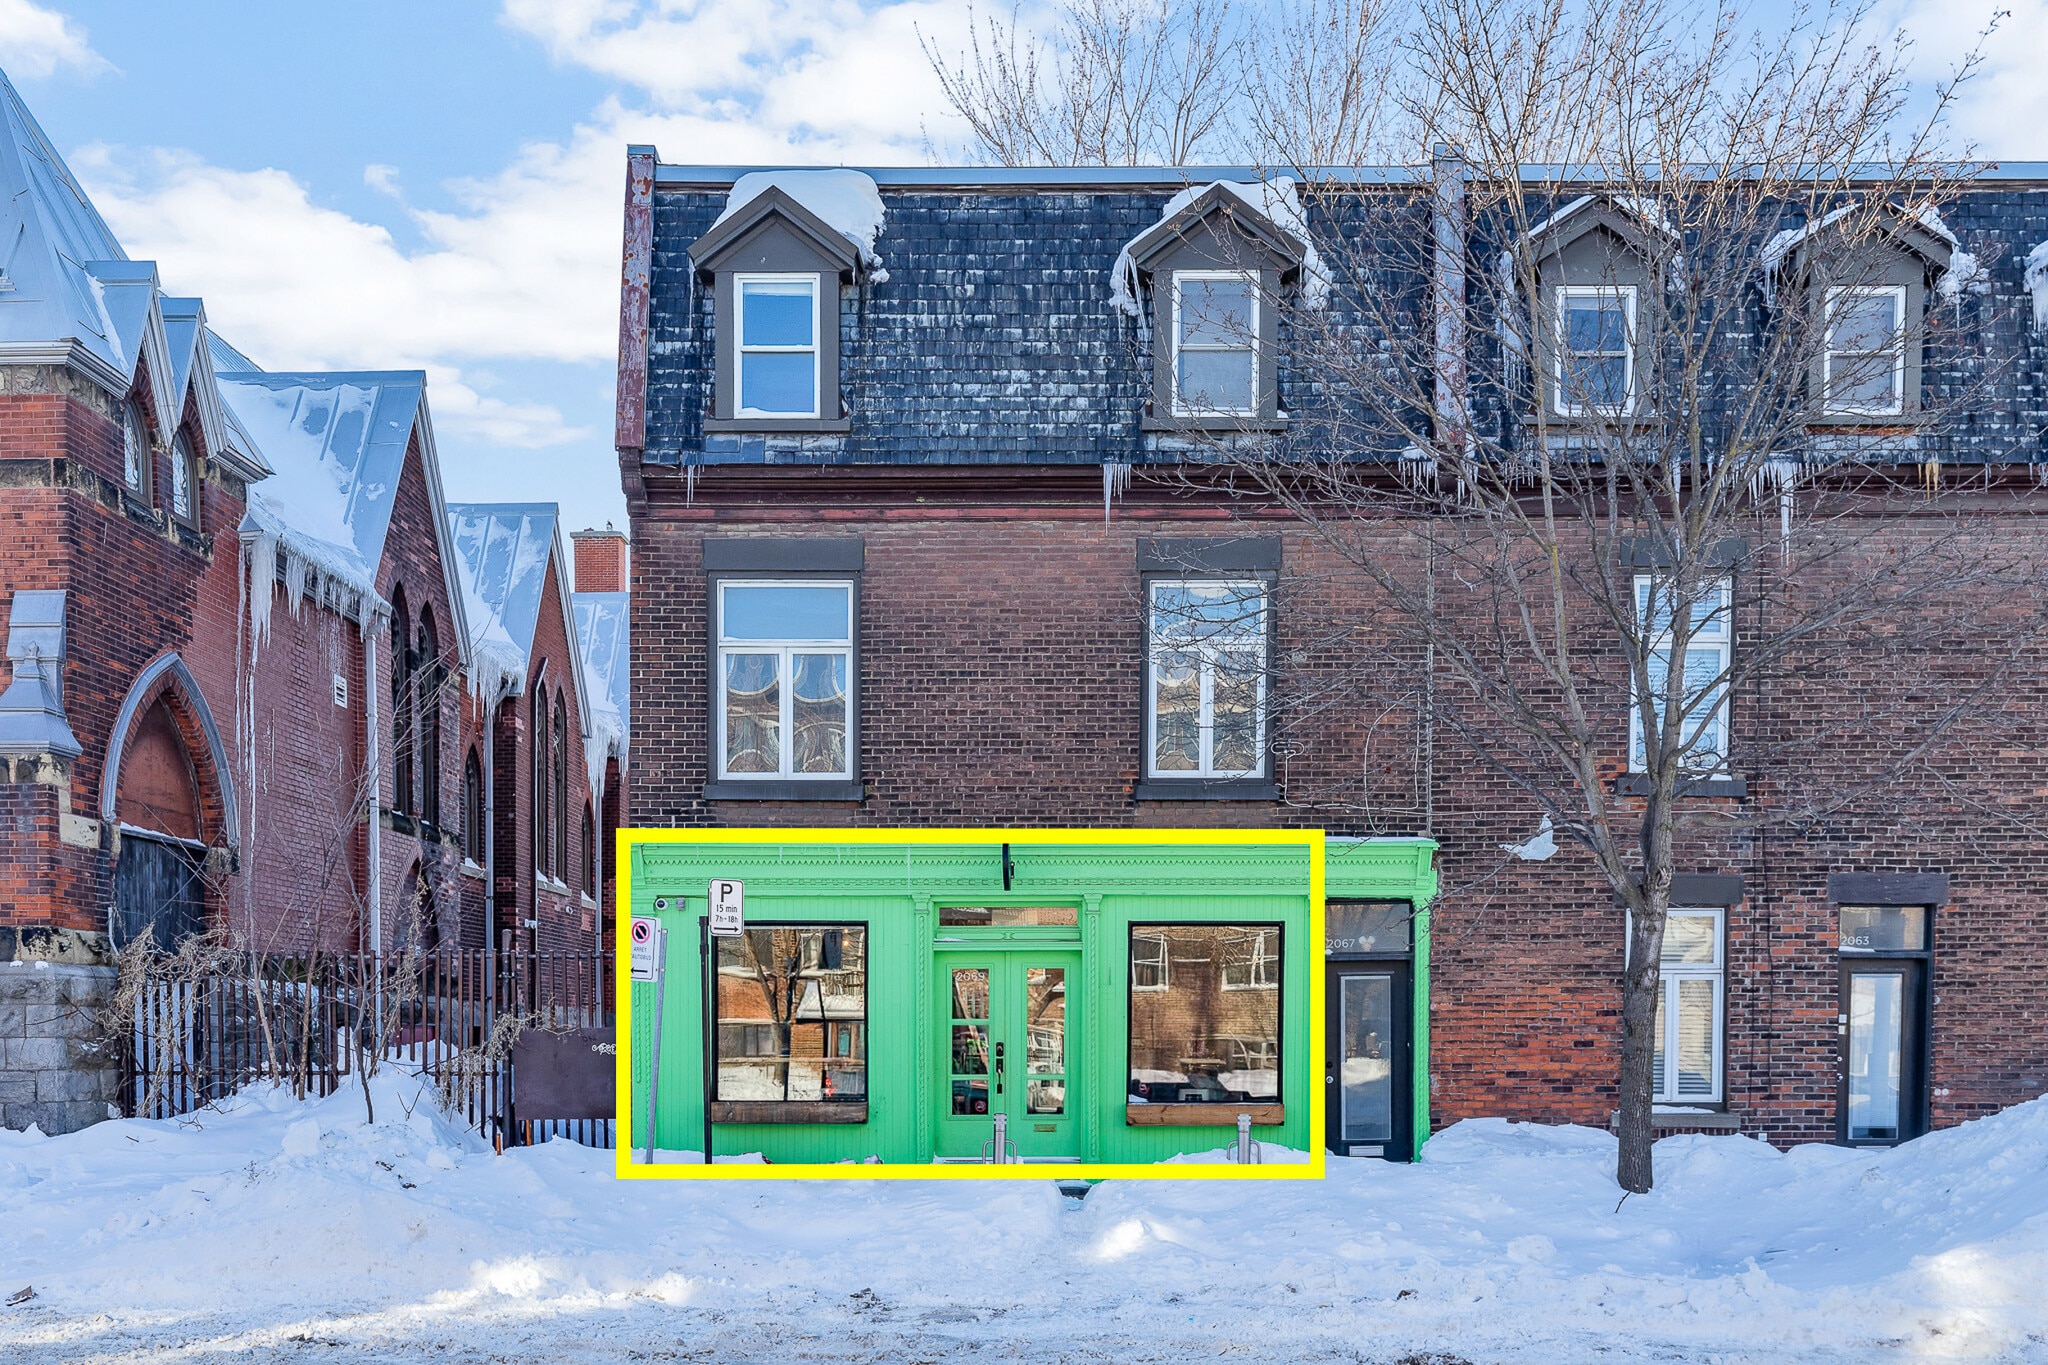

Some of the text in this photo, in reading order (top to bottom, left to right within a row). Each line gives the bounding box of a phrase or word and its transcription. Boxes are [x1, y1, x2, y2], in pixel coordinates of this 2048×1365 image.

[721, 883, 733, 902] P
[716, 904, 738, 913] 15 min
[1326, 938, 1355, 949] 2067
[1841, 935, 1870, 946] 2063
[955, 971, 985, 982] 2069
